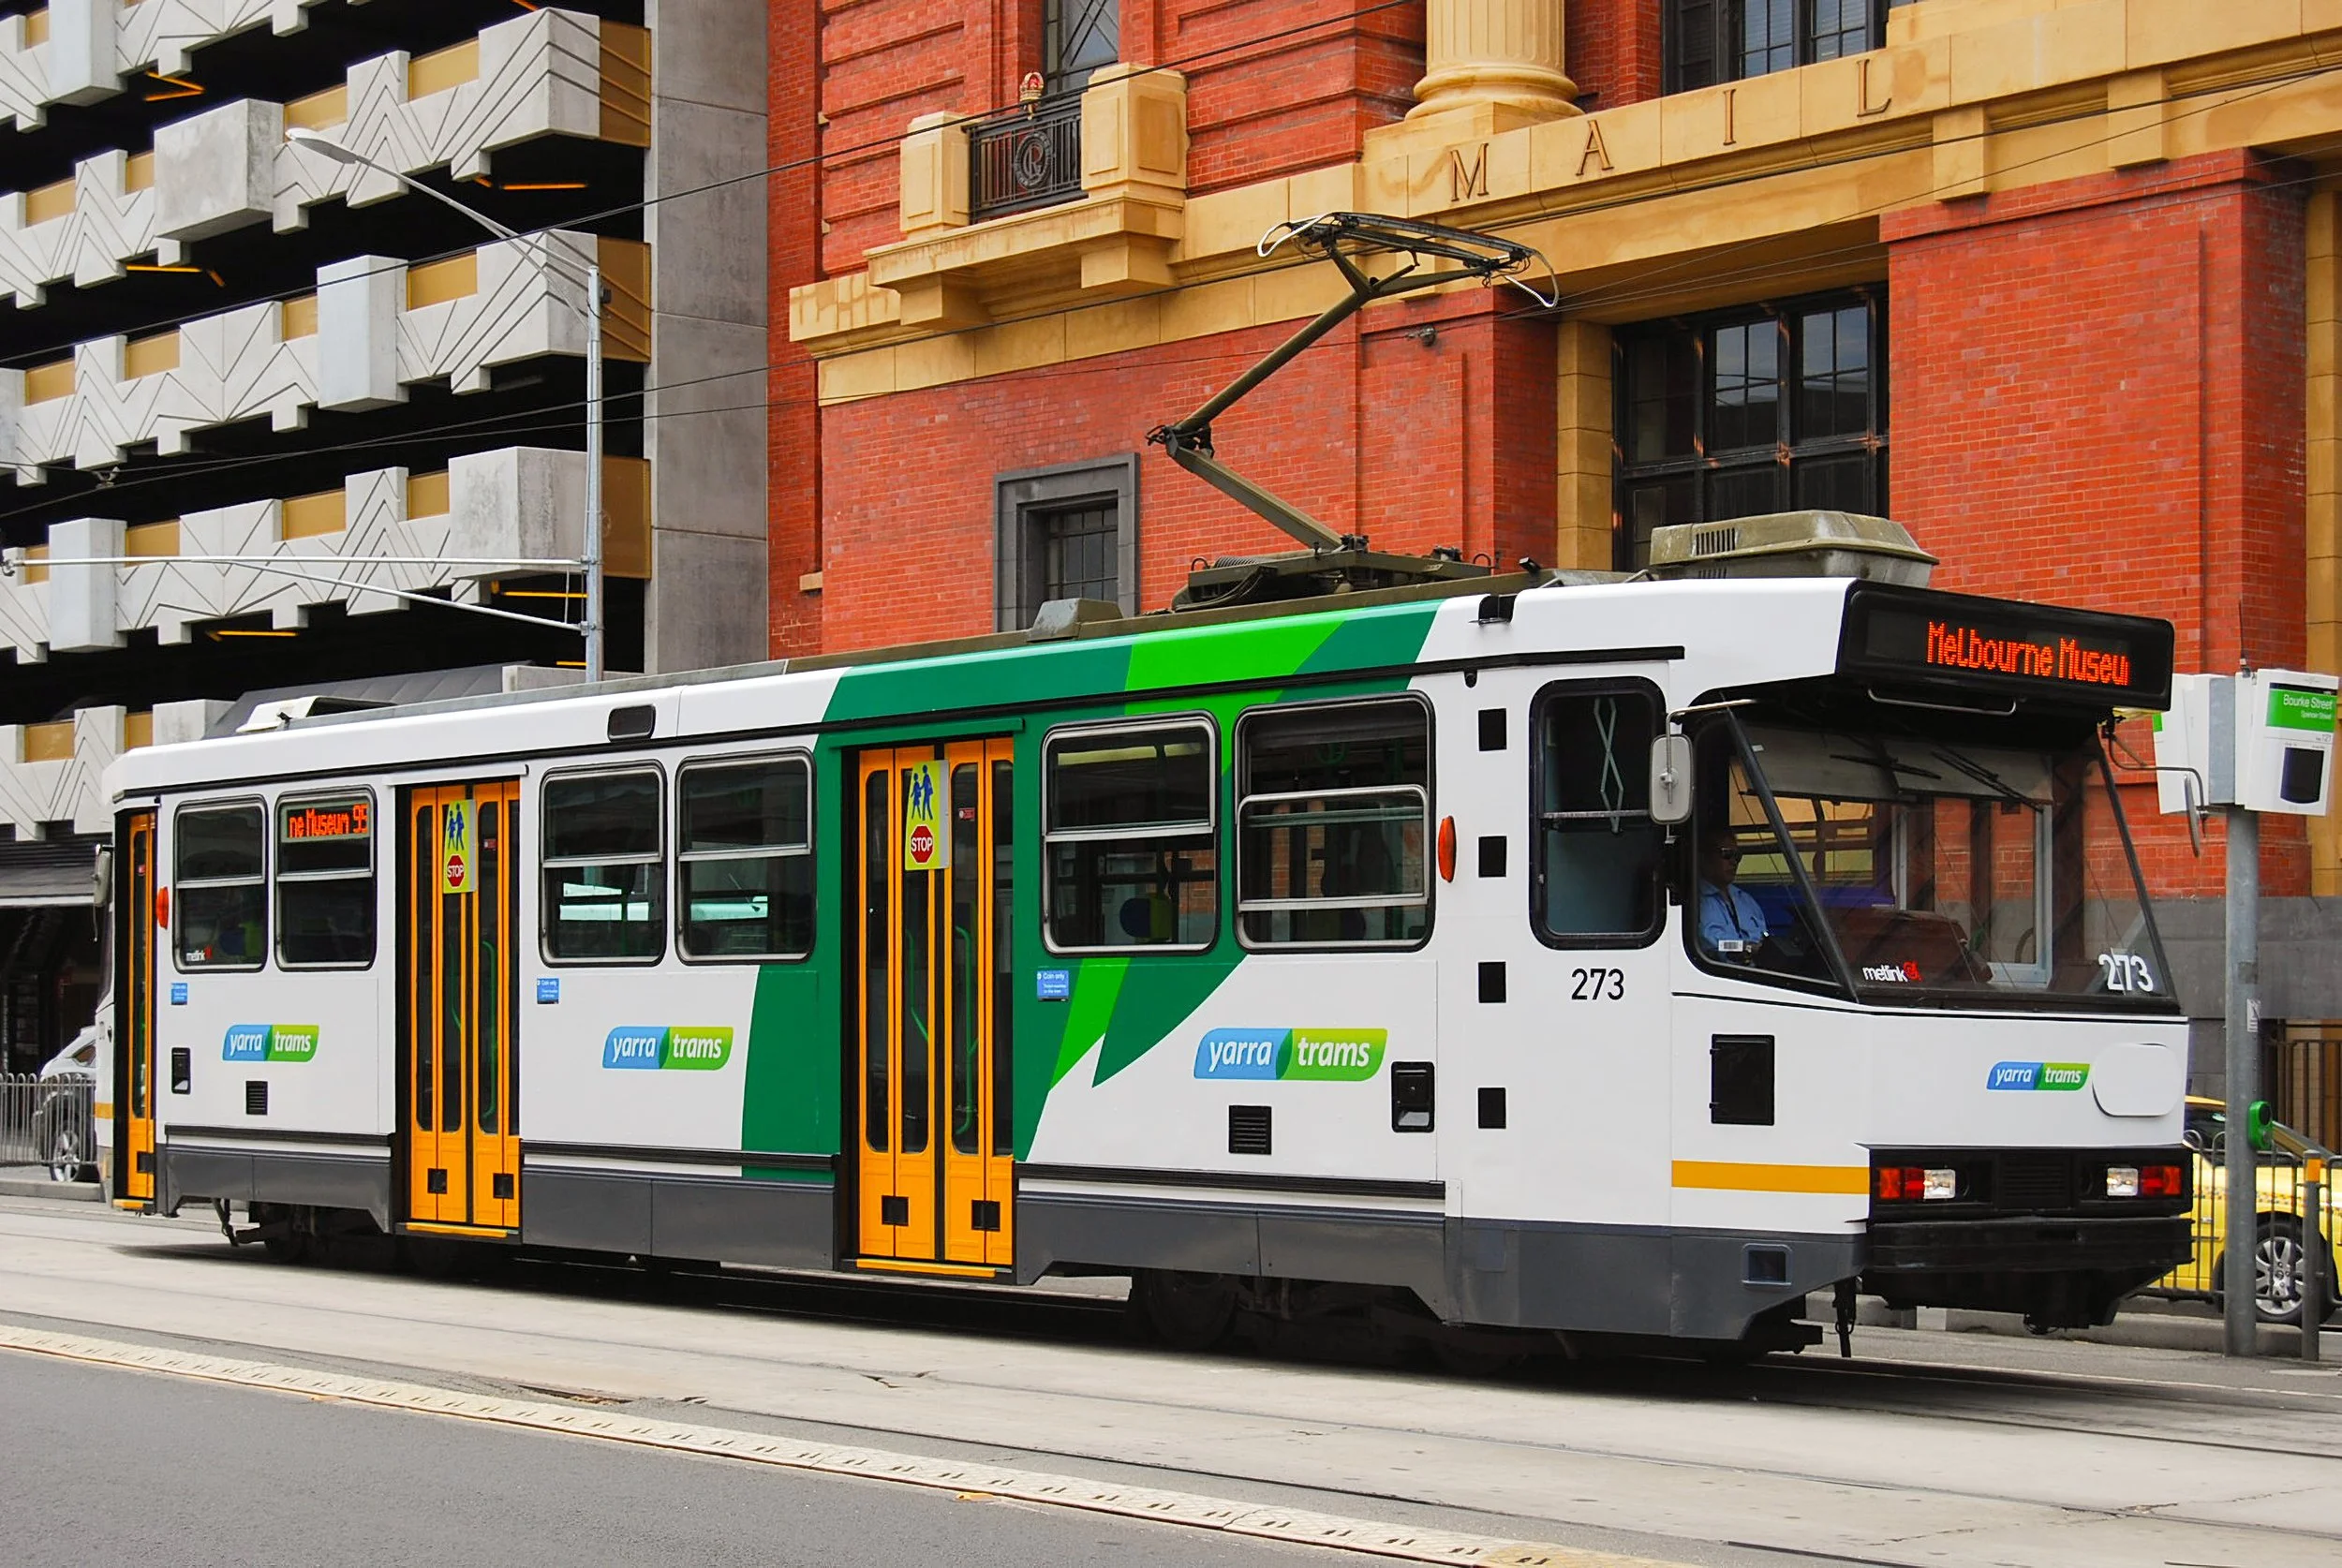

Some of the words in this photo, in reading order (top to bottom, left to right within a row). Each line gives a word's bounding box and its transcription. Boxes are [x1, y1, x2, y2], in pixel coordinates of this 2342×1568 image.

[1449, 58, 1892, 202] MAIL
[1926, 621, 2053, 677] Melbourne
[2283, 694, 2310, 707] Bourke
[2310, 697, 2333, 710] Street
[306, 807, 350, 837] Museum
[911, 836, 933, 852] STOP
[447, 865, 465, 878] STOP
[1571, 968, 1624, 1000] 273
[2098, 954, 2154, 992] 273
[230, 1033, 263, 1057] yarra
[274, 1030, 312, 1052] trams
[612, 1036, 657, 1063] yarra
[673, 1033, 723, 1058] trams
[1208, 1040, 1274, 1072] yarra
[1297, 1037, 1371, 1068] trams
[1994, 1067, 2033, 1087] yarra
[2044, 1066, 2083, 1084] trams
